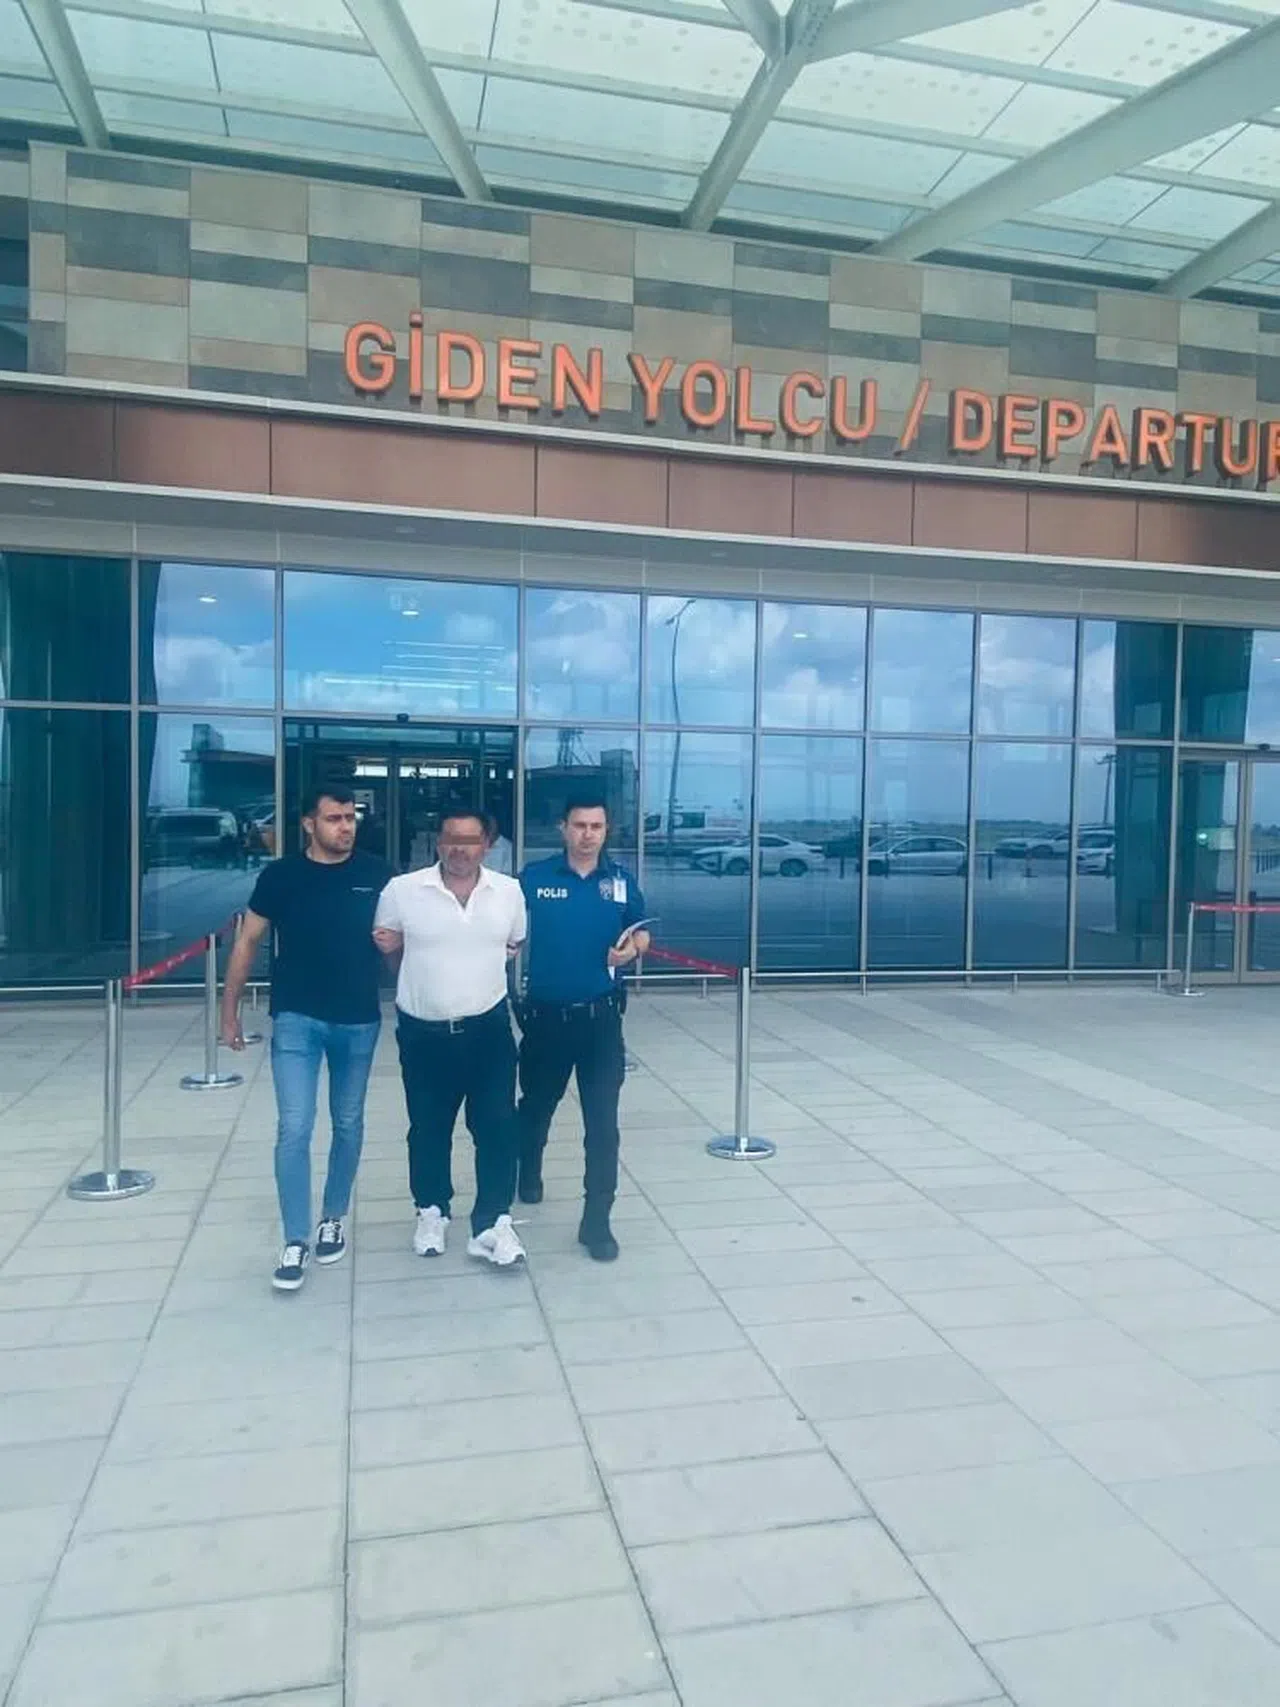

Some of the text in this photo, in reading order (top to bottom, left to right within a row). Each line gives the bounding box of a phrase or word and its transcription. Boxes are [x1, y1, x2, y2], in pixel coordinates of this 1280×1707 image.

[343, 311, 603, 419] GİDEN
[628, 352, 879, 442] YOLCU
[895, 377, 933, 456] /
